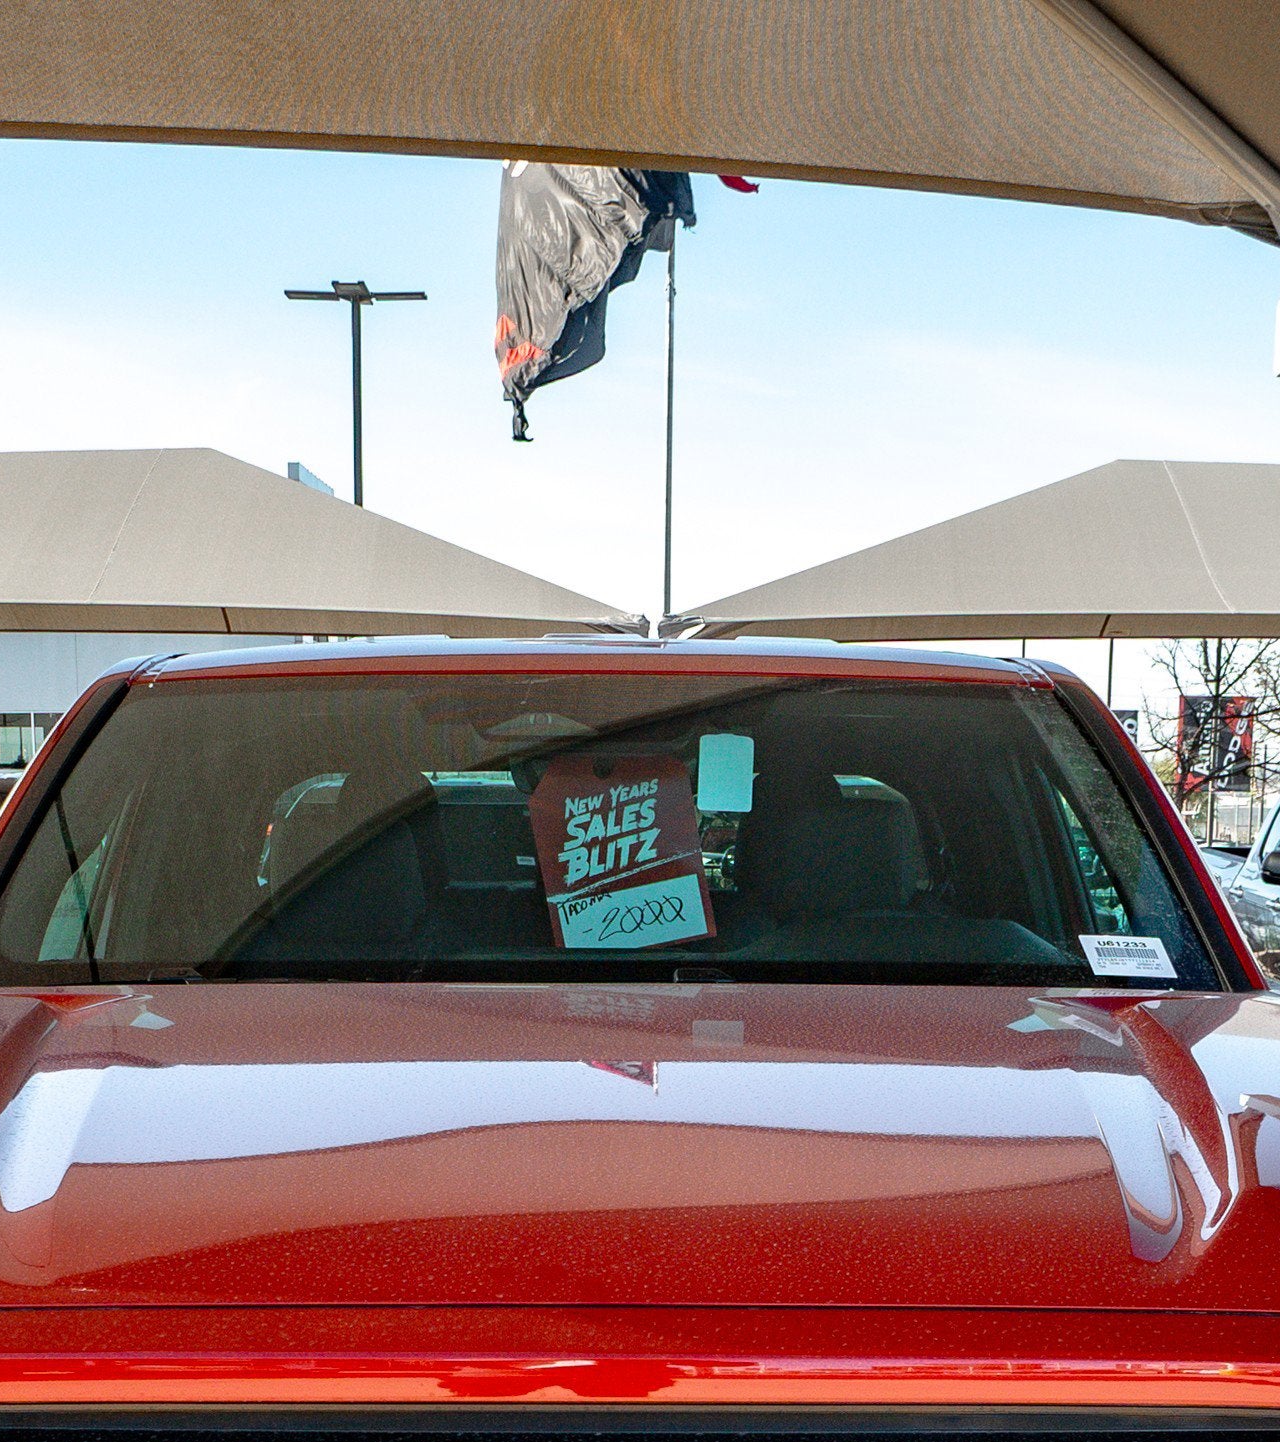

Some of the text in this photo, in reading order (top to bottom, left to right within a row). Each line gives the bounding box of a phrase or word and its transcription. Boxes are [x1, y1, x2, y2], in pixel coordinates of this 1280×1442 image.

[563, 798, 658, 850] SALES
[564, 778, 659, 820] NEW YEARS
[558, 827, 662, 887] BLITZ
